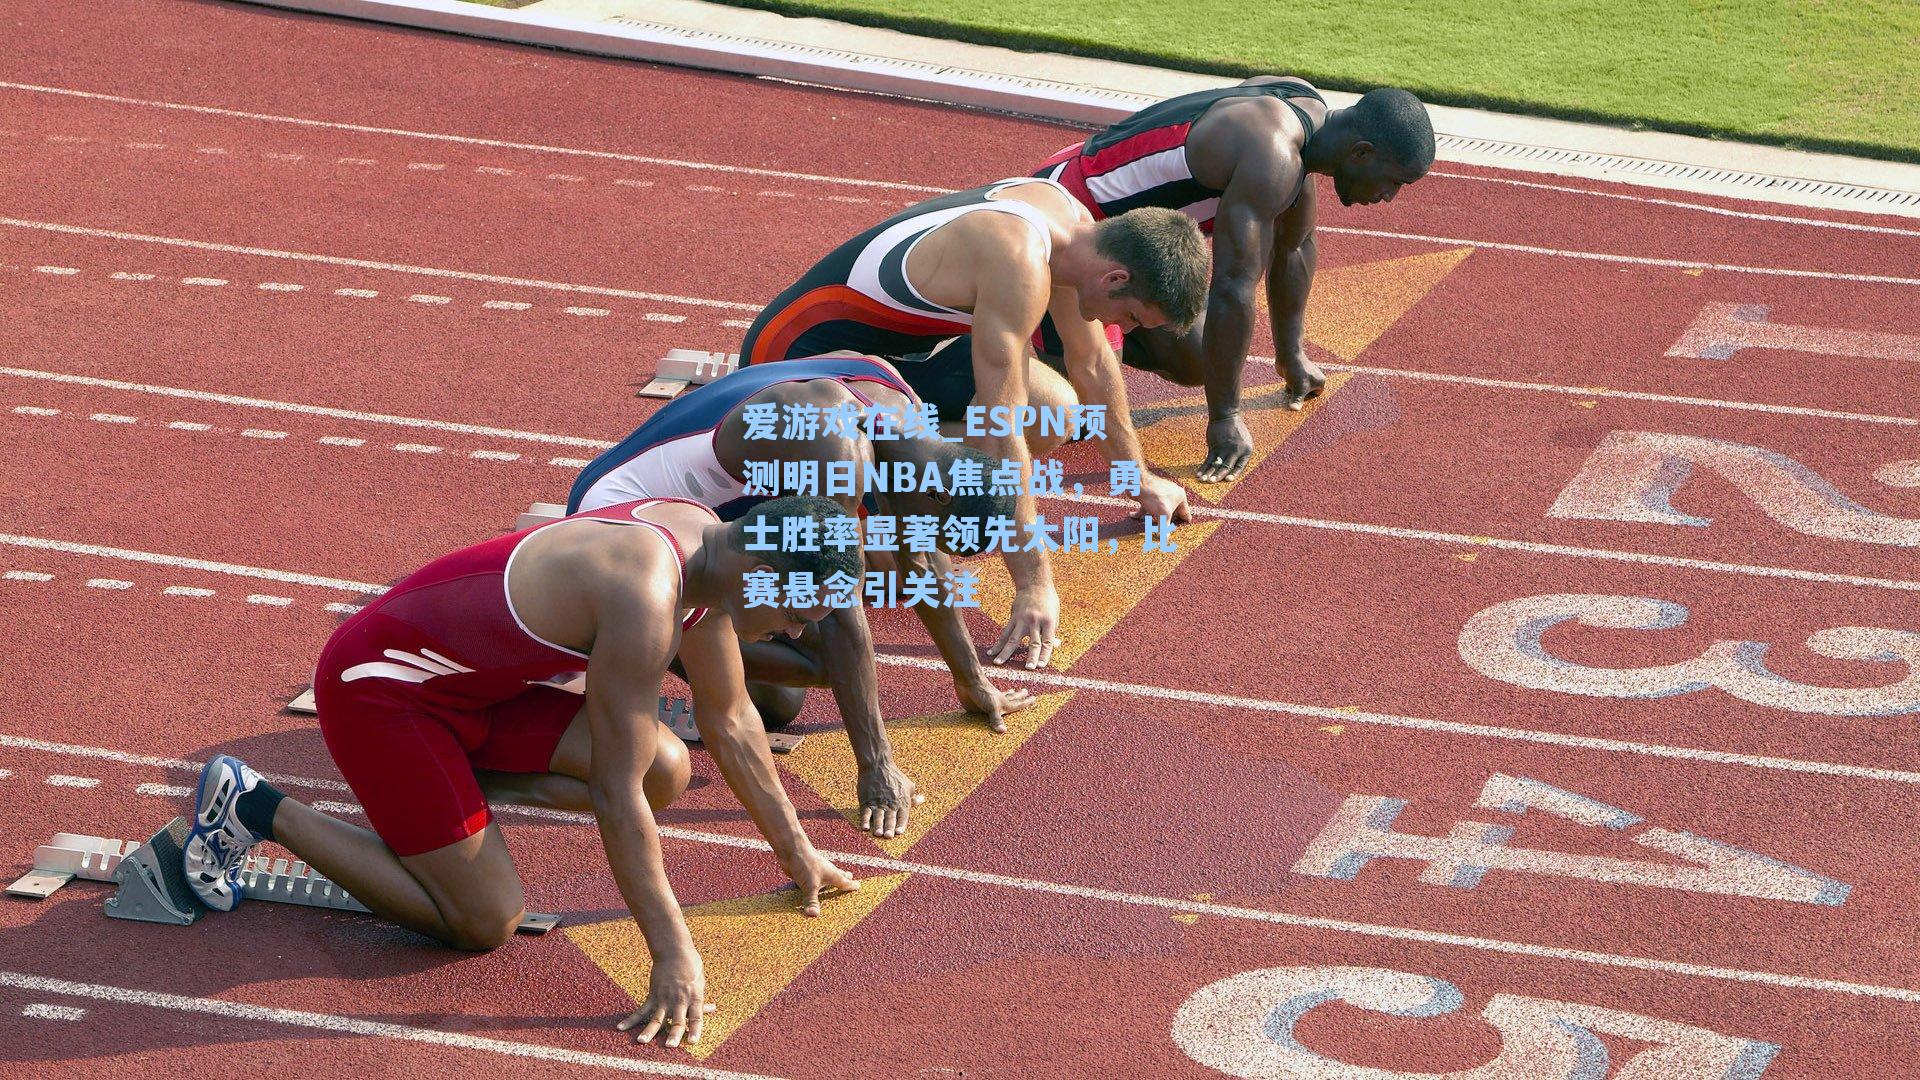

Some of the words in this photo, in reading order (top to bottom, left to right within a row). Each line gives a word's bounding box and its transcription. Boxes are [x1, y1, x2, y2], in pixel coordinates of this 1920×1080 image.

[1547, 430, 1920, 547] 2
[1457, 593, 1920, 717] 3
[1290, 772, 1853, 906] 4
[1170, 966, 1783, 1080] 5
